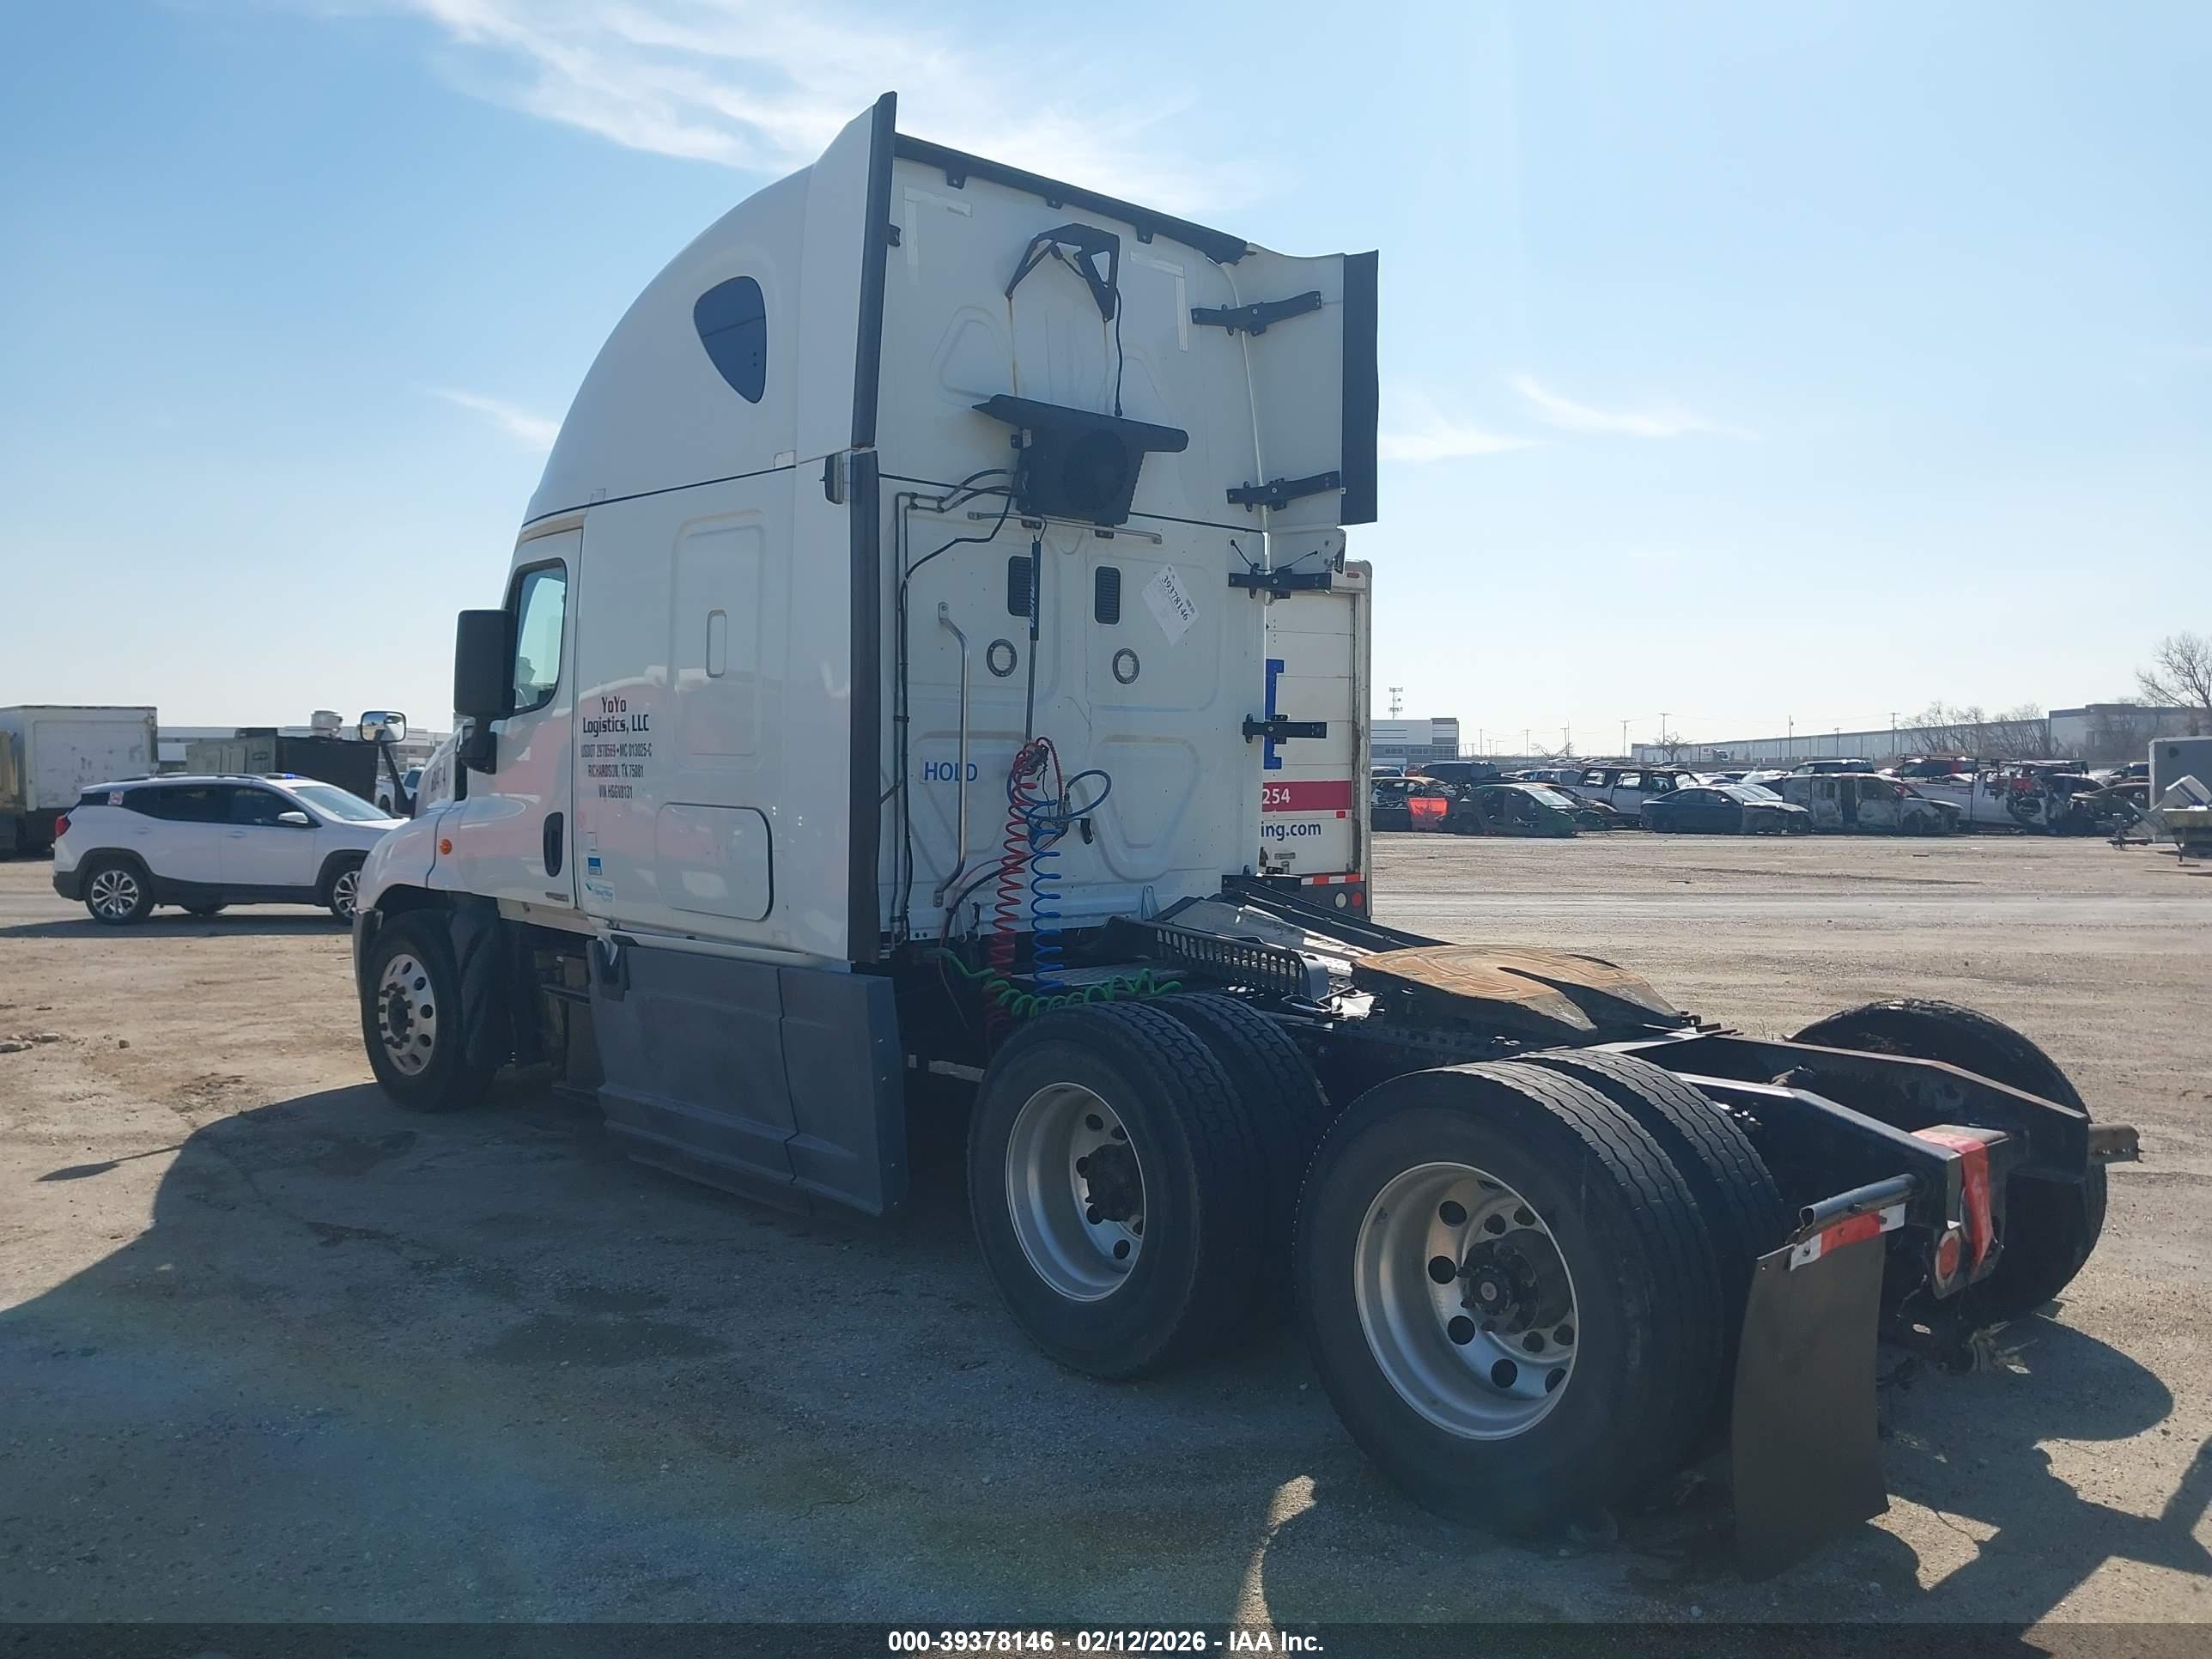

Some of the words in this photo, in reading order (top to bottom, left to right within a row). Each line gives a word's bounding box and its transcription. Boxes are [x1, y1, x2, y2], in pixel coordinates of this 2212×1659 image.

[1161, 574, 1189, 621] 39378146
[601, 696, 627, 714] YoYo
[583, 716, 629, 738] Logistics,
[632, 714, 650, 732] LLC
[619, 743, 628, 757] MC
[621, 763, 628, 777] TX
[924, 762, 978, 781] HOLD
[1261, 820, 1322, 842] ing.com
